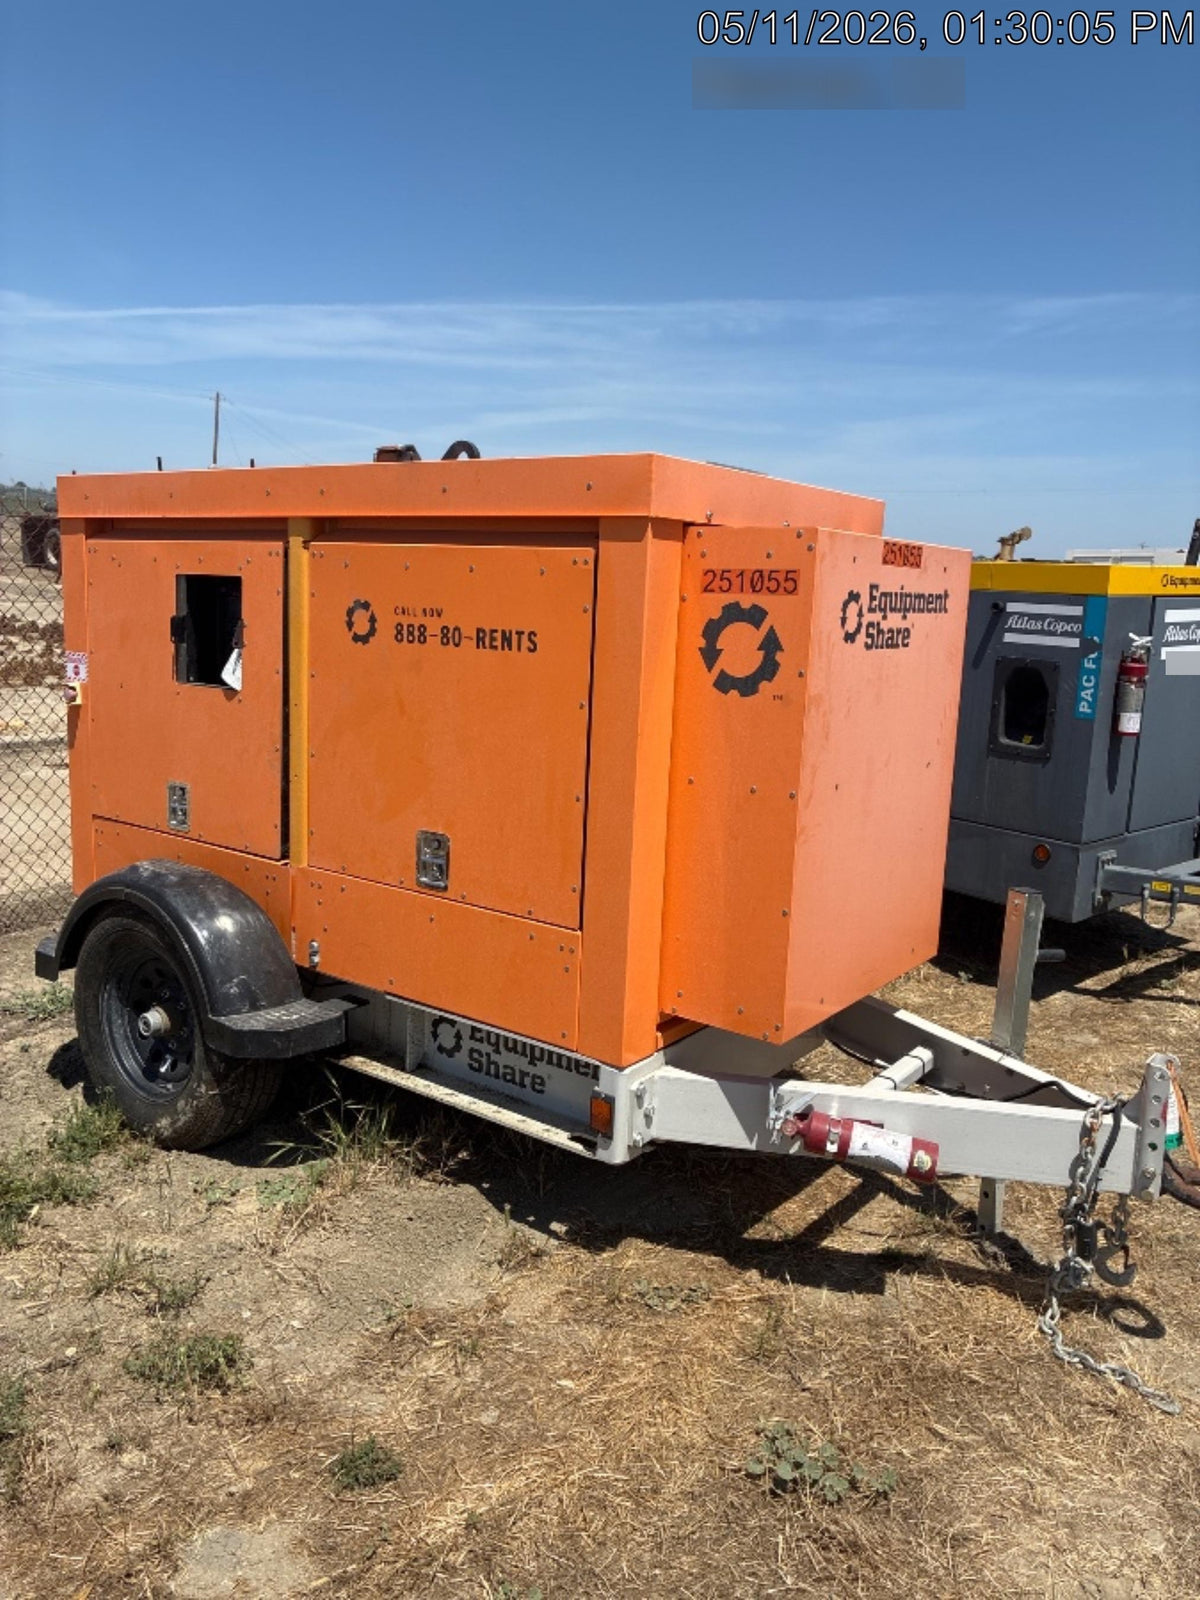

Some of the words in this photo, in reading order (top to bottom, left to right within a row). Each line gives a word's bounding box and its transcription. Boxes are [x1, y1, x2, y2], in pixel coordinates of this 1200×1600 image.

[702, 570, 798, 594] 251055
[867, 584, 949, 620] Equipment
[394, 622, 538, 653] 888-80-RENTS
[864, 622, 912, 650] Share
[1004, 615, 1042, 630] Atlas
[1043, 617, 1082, 634] Copco
[1079, 675, 1096, 714] PAC
[467, 1046, 546, 1094] Share
